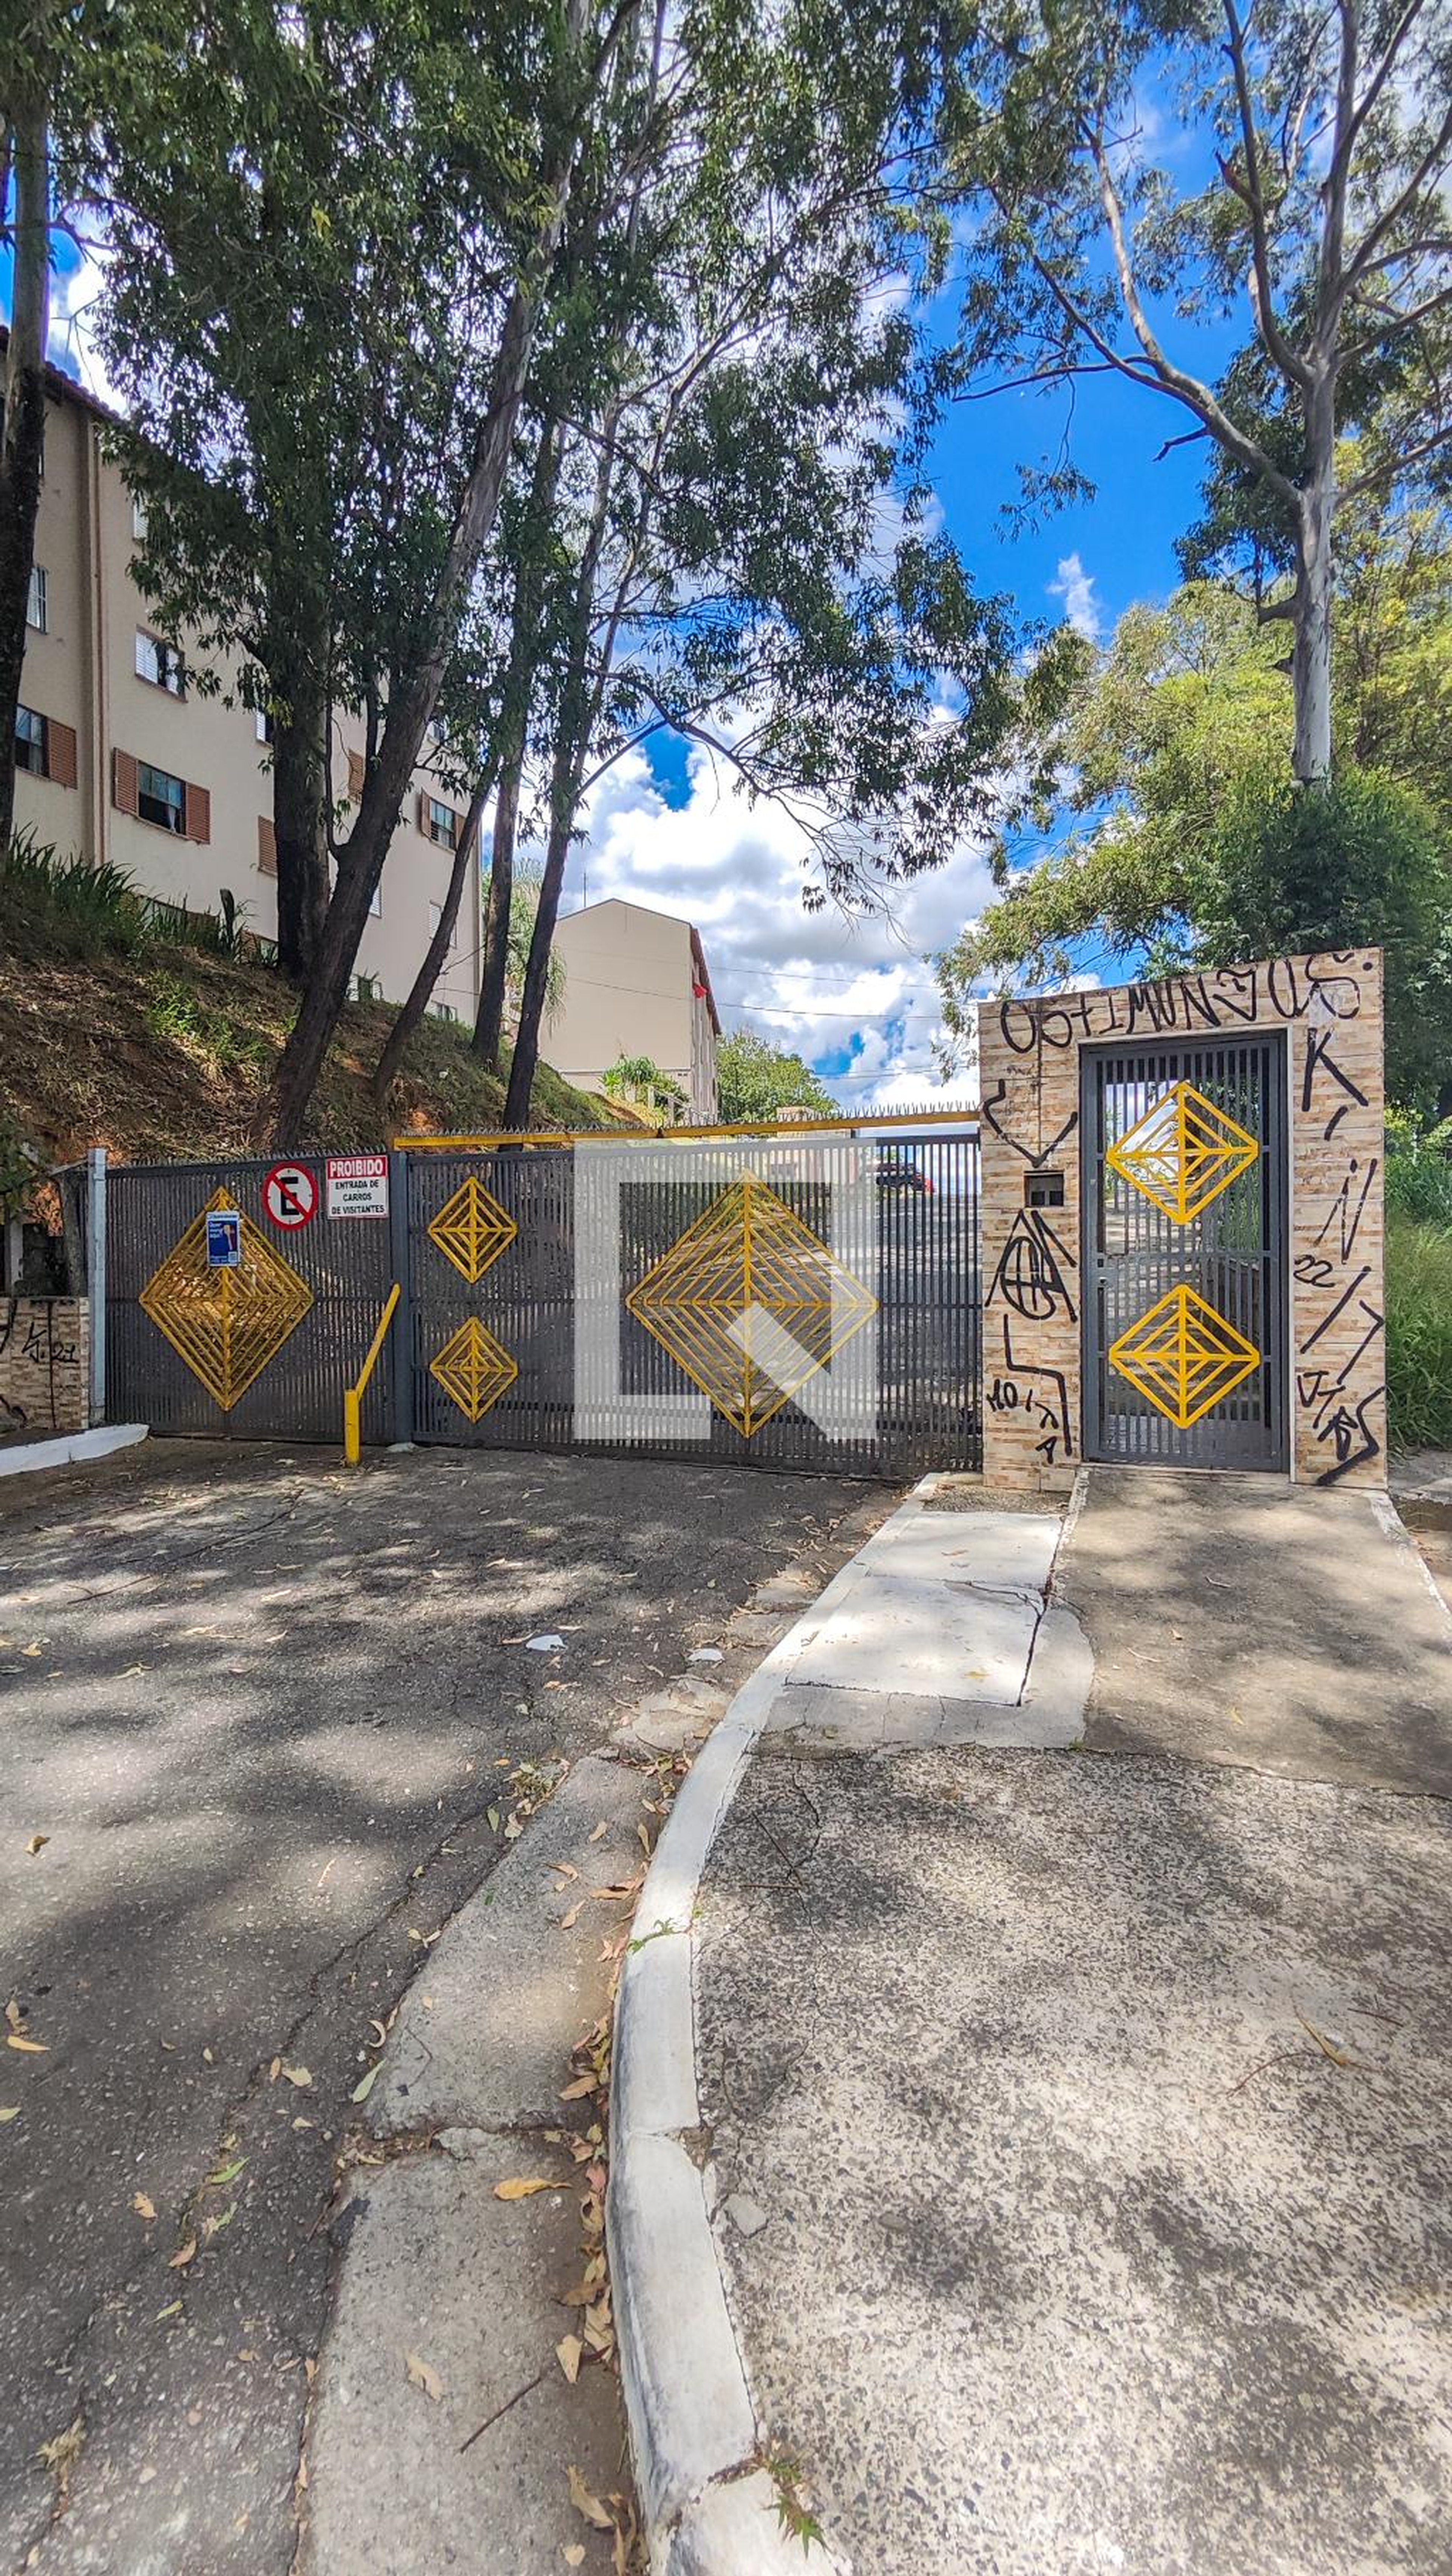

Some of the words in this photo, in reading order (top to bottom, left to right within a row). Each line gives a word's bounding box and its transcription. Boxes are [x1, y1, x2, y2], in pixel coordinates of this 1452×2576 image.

[330, 1159, 383, 1177] PROIBIDO
[335, 1180, 368, 1190] ENTRADA
[370, 1179, 379, 1187] DE
[281, 1176, 299, 1215] E
[343, 1192, 372, 1201] CARROS
[343, 1204, 385, 1214] VISITANTES
